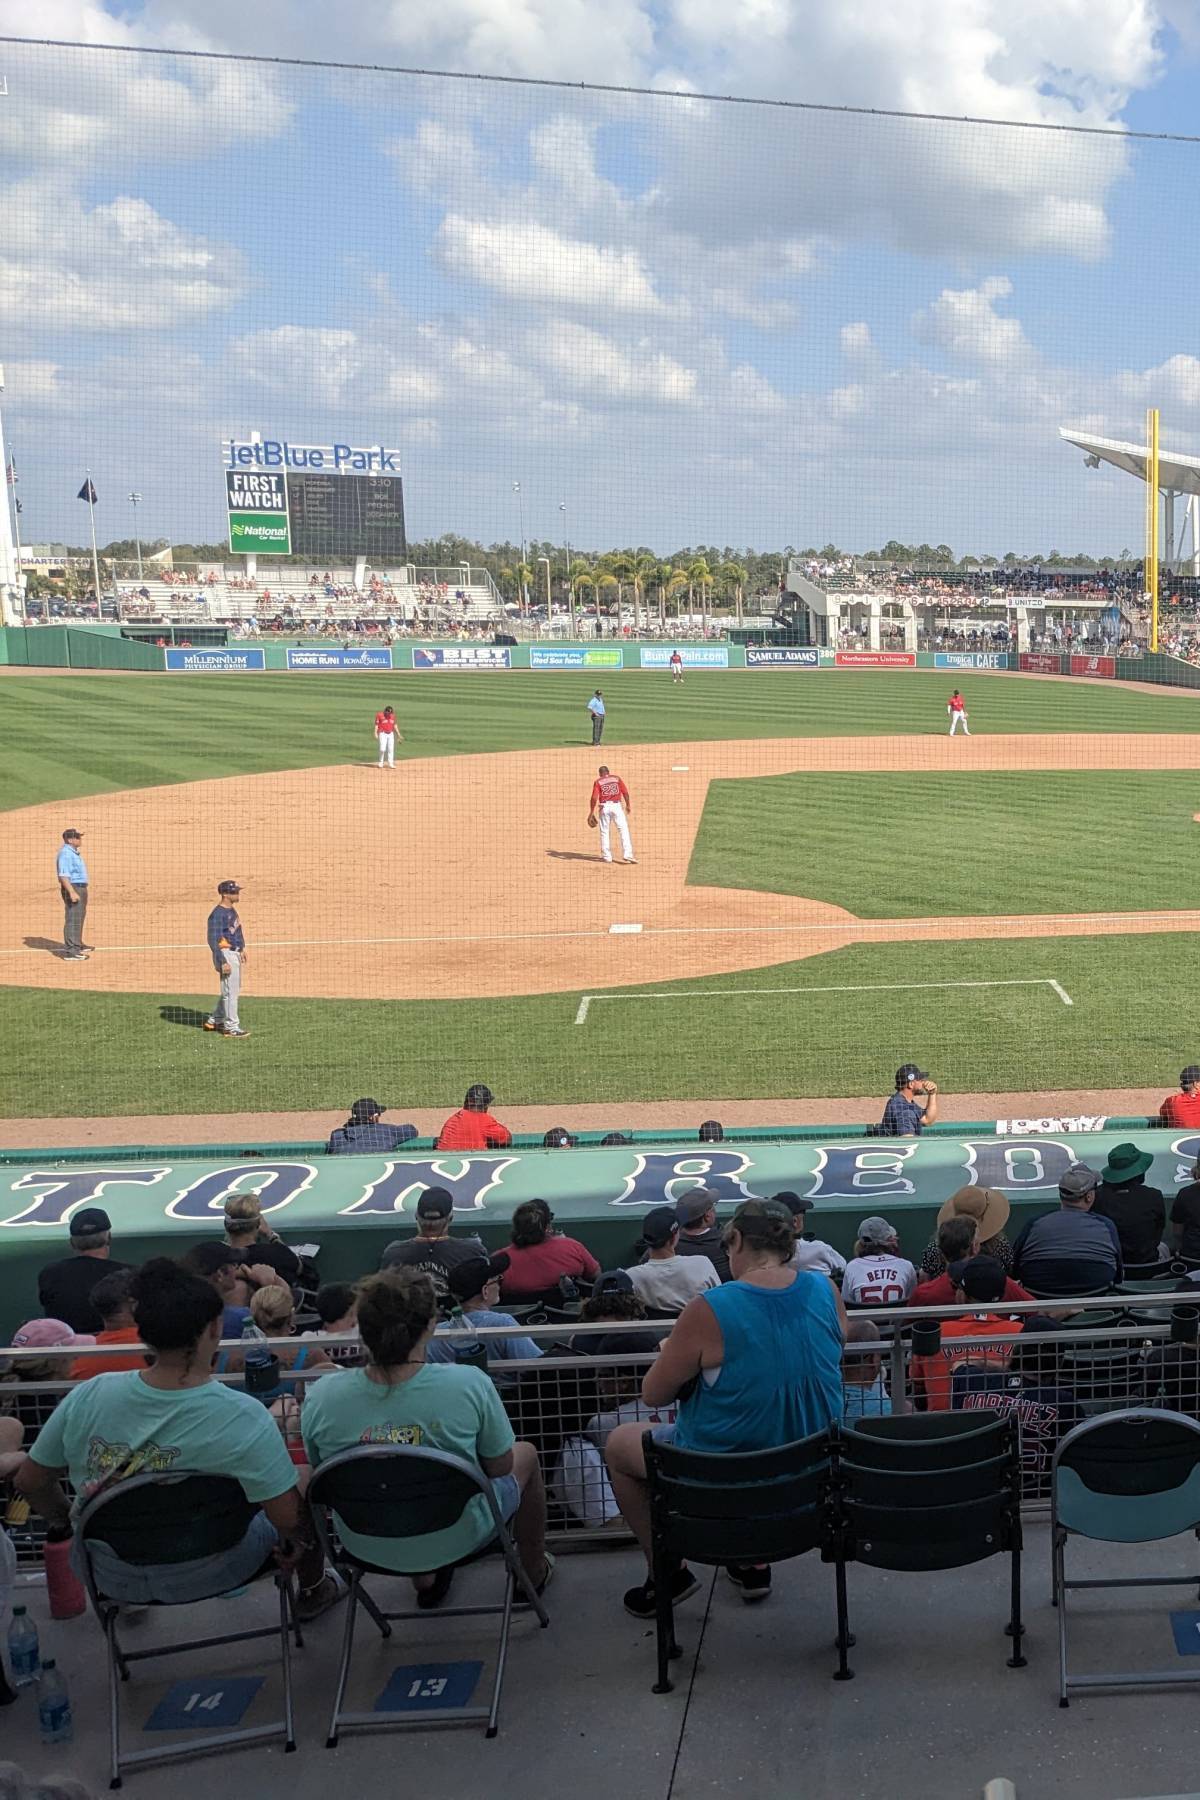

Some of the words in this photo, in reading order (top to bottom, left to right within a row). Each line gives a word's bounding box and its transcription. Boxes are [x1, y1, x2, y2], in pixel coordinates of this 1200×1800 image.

[229, 439, 324, 469] jetBlue
[333, 444, 397, 470] Park
[233, 475, 278, 491] FIRST
[230, 491, 283, 508] WATCH
[244, 526, 287, 536] National
[292, 656, 317, 665] HOME
[443, 649, 506, 659] BEST
[748, 651, 785, 662] SAMUEL
[785, 651, 817, 662] ADAMS
[820, 650, 834, 658] 380
[946, 654, 974, 664] tropical
[976, 654, 1000, 668] CAFE
[610, 1139, 1086, 1206] RED
[866, 1268, 898, 1282] BETTS
[861, 1284, 904, 1304] 50
[407, 1678, 448, 1697] 13
[183, 1691, 224, 1711] 14
